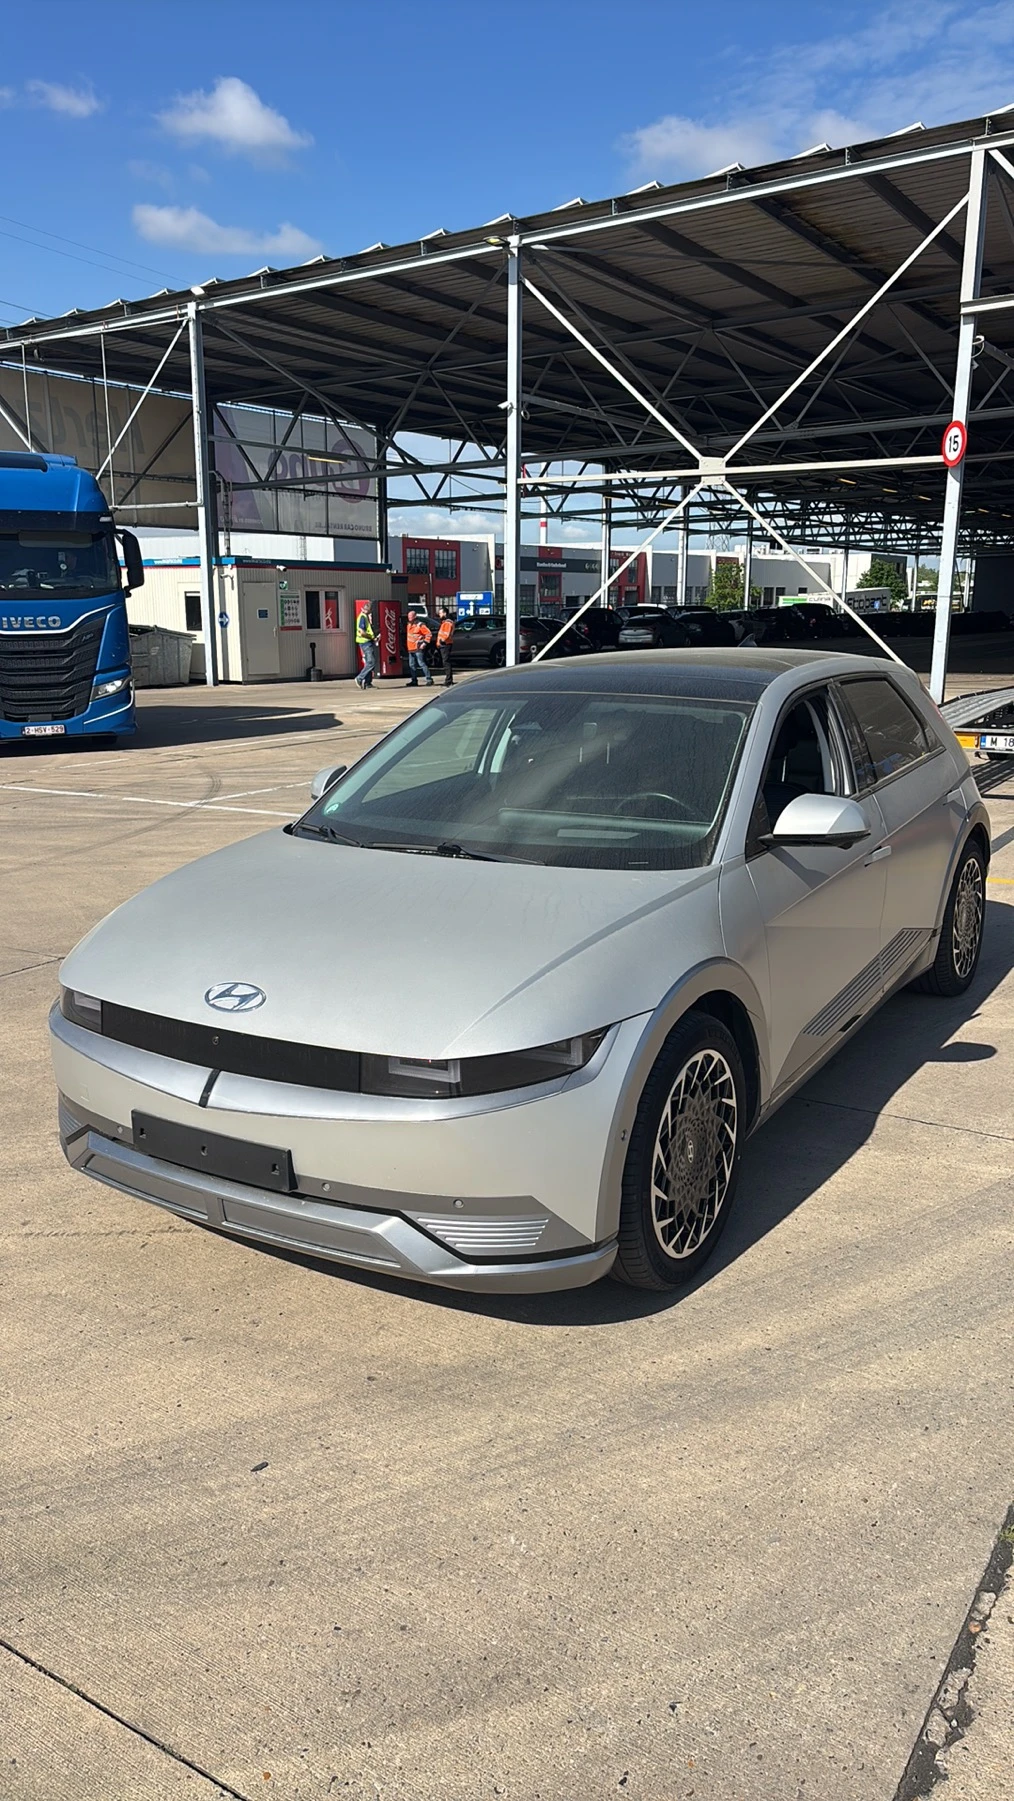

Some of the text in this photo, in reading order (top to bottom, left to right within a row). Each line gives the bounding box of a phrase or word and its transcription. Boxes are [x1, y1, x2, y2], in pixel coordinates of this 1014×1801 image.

[948, 434, 960, 453] 15
[1, 615, 62, 629] IVECO
[990, 736, 998, 747] M
